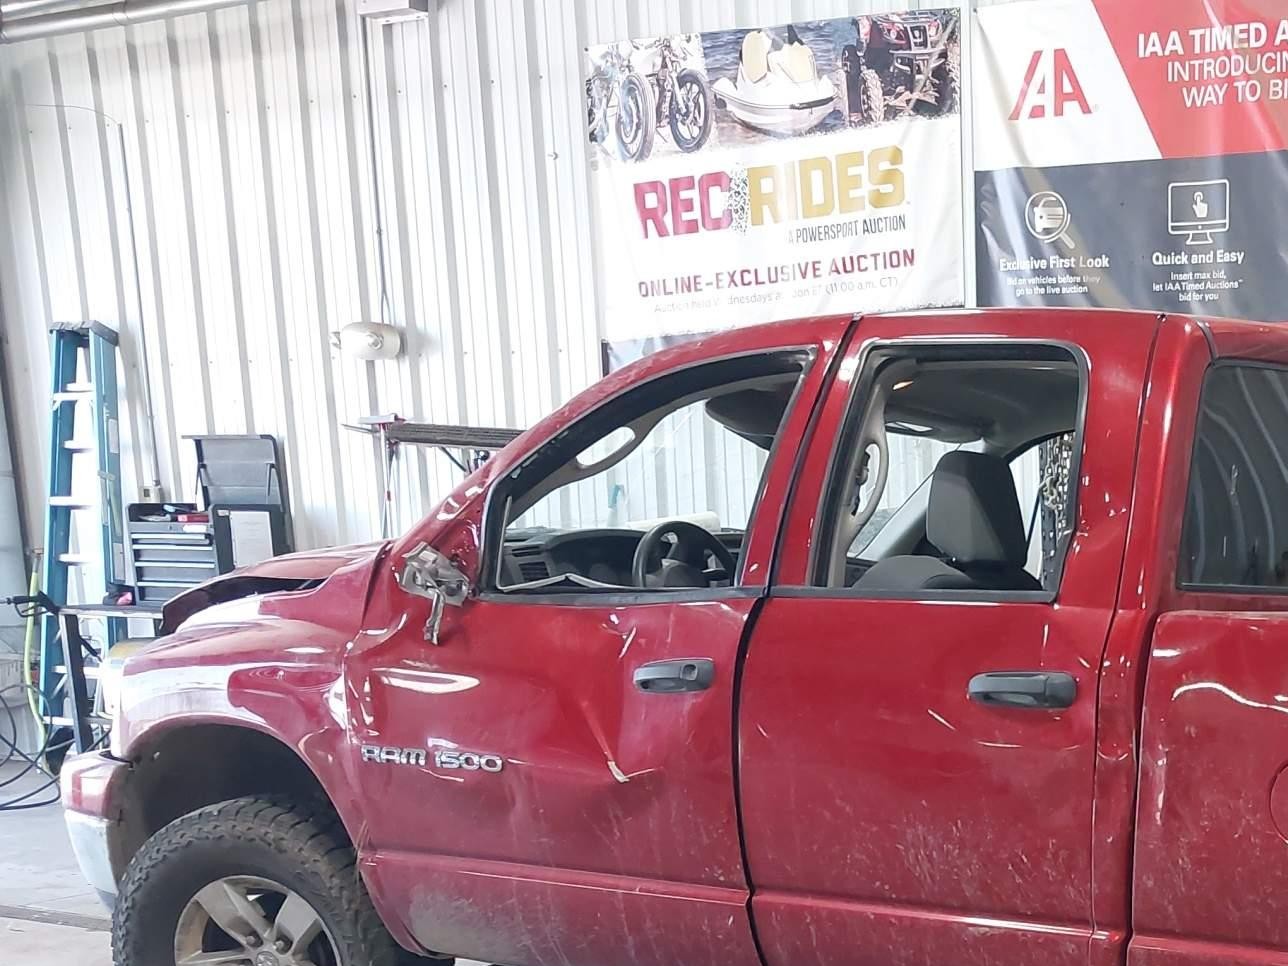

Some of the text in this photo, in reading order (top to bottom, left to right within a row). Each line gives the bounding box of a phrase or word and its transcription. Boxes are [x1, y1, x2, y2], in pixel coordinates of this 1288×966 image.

[1138, 30, 1184, 58] IAA
[1189, 22, 1268, 54] TIMED
[1182, 83, 1228, 108] WAY
[1233, 79, 1261, 103] TO
[633, 145, 905, 239] REC RIDES
[796, 219, 859, 243] POWERSPORT
[862, 214, 906, 234] AUCTION
[1000, 254, 1109, 271] Exclusive First Look
[1152, 249, 1244, 265] Quick and Easy
[638, 248, 915, 298] ONLINE-EXCLUSIVE AUCTION
[1026, 275, 1056, 284] vehicles
[1058, 274, 1080, 283] before
[1170, 271, 1193, 280] Insert
[1194, 272, 1211, 280] max
[1016, 288, 1025, 297] go
[1033, 286, 1045, 294] the
[1046, 286, 1060, 294] live
[1061, 285, 1088, 294] auction
[1152, 282, 1163, 291] let
[1165, 282, 1180, 290] IAA
[1181, 281, 1204, 290] Timed
[1179, 292, 1218, 302] bid for you
[361, 744, 503, 772] RAM 1500
